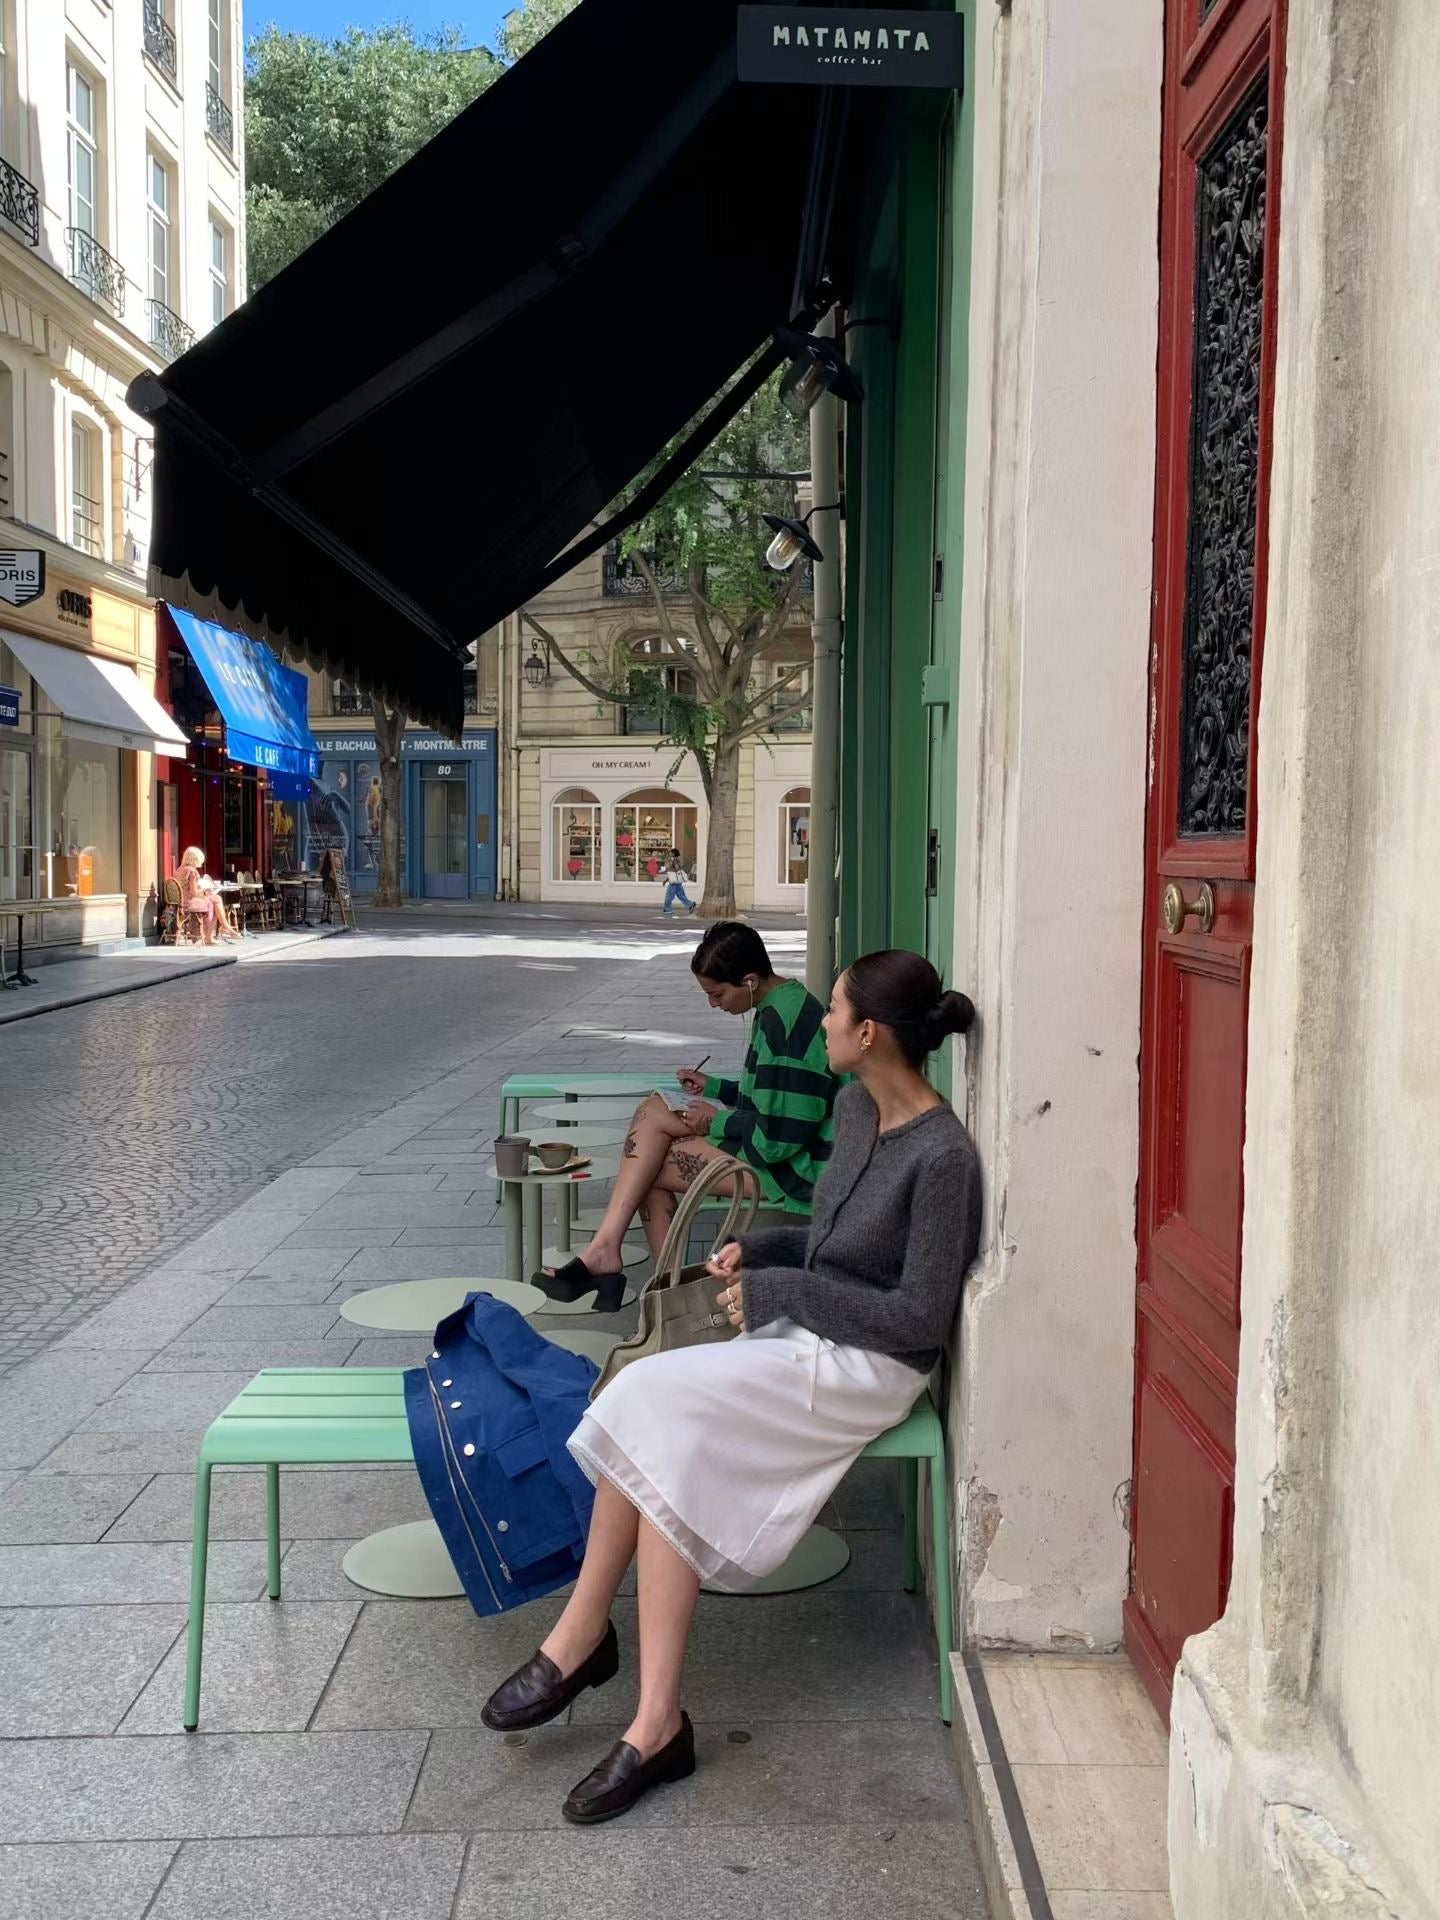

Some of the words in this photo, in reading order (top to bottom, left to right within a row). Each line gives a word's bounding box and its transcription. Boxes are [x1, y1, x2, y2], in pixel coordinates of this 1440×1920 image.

[773, 25, 930, 51] MATAMATA
[817, 55, 856, 65] coffee
[862, 56, 883, 65] bar
[0, 569, 35, 581] ORIS
[414, 740, 487, 751] MONTMRTRE
[255, 745, 263, 763] LE
[437, 765, 452, 775] 80
[591, 761, 604, 769] OH
[605, 761, 618, 769] MY
